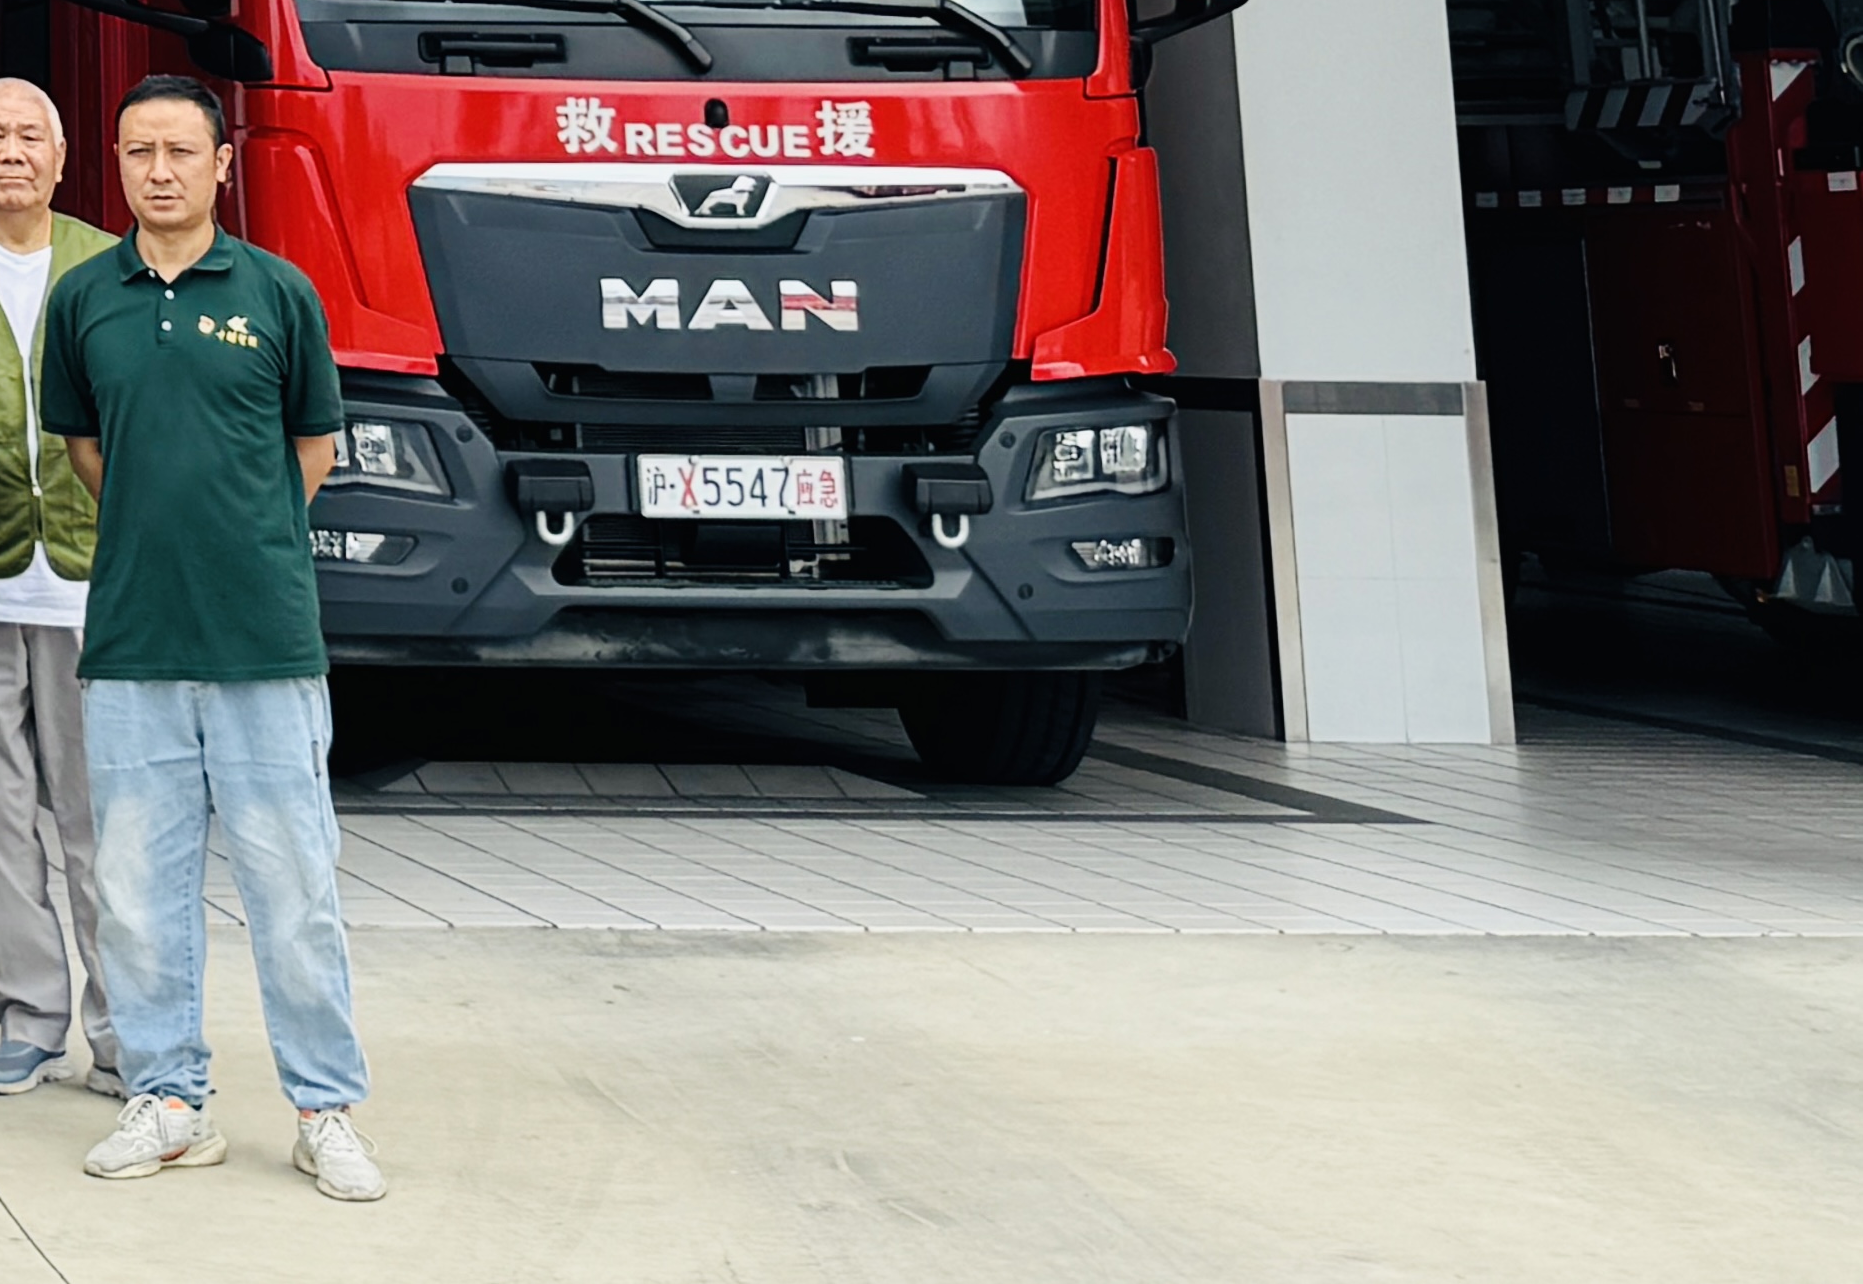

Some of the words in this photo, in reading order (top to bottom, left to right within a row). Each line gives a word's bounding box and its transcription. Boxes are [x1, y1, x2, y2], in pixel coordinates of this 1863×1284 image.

[555, 97, 618, 154] 救
[624, 123, 812, 159] RESCUE
[815, 100, 876, 159] 援
[600, 277, 860, 331] MAN
